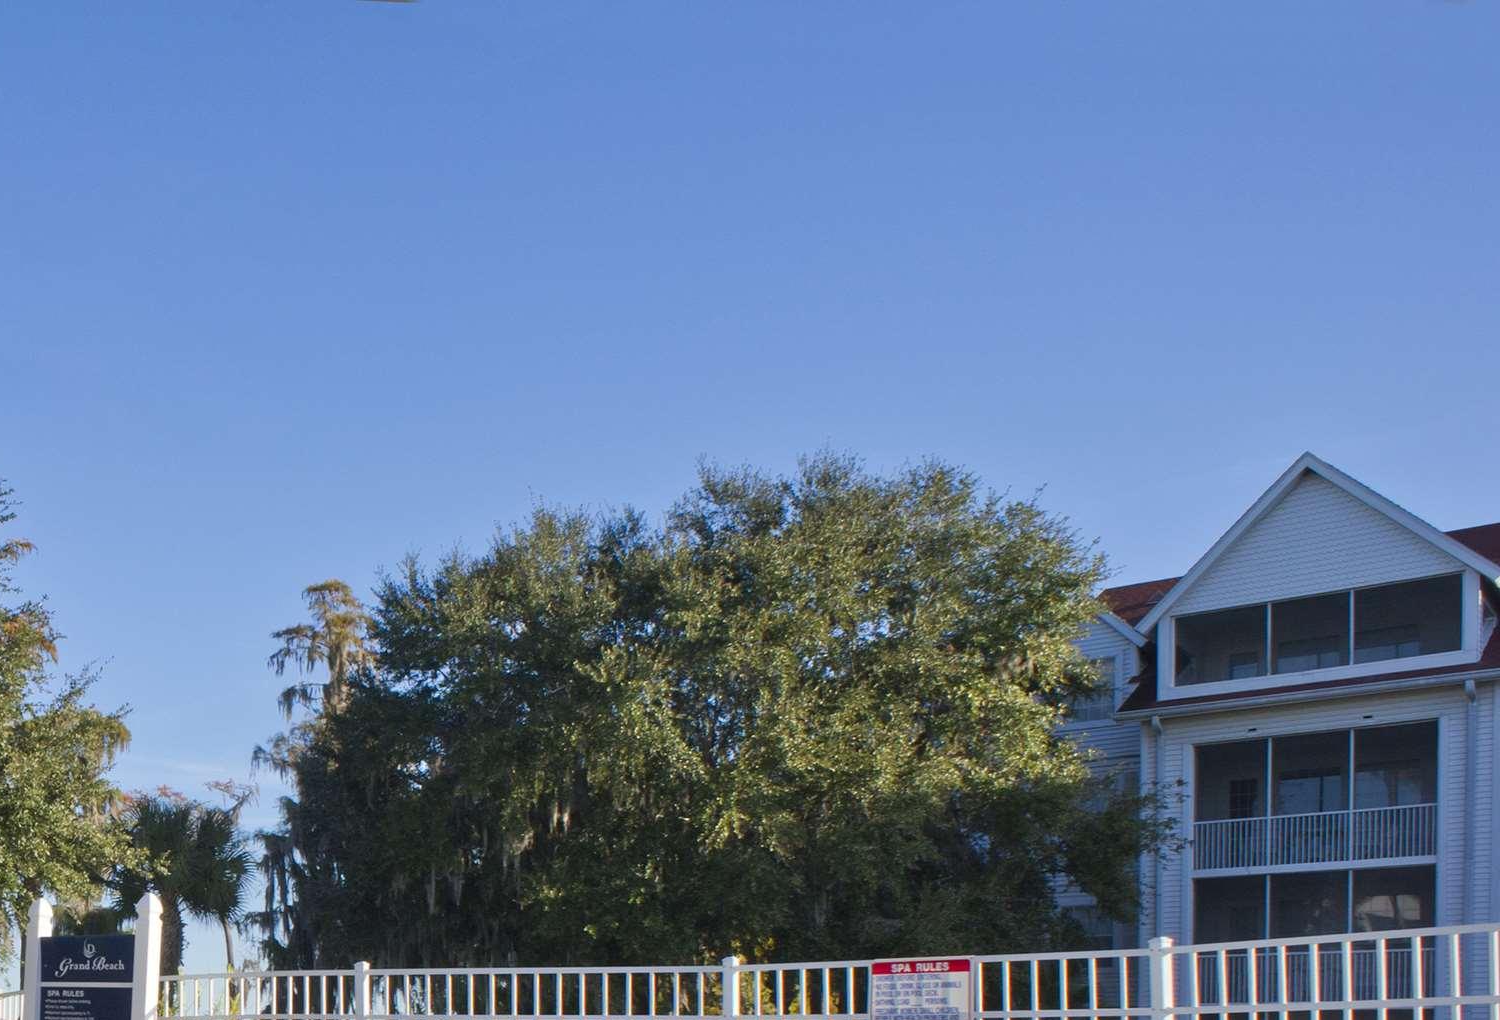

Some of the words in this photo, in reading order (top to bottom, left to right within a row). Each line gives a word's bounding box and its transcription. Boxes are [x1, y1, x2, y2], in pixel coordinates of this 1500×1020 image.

[55, 957, 91, 978] Grand
[92, 956, 125, 971] Beach
[891, 963, 911, 973] SPA
[915, 961, 950, 972] RULES
[46, 990, 60, 998] SPA
[62, 990, 85, 998] RULES
